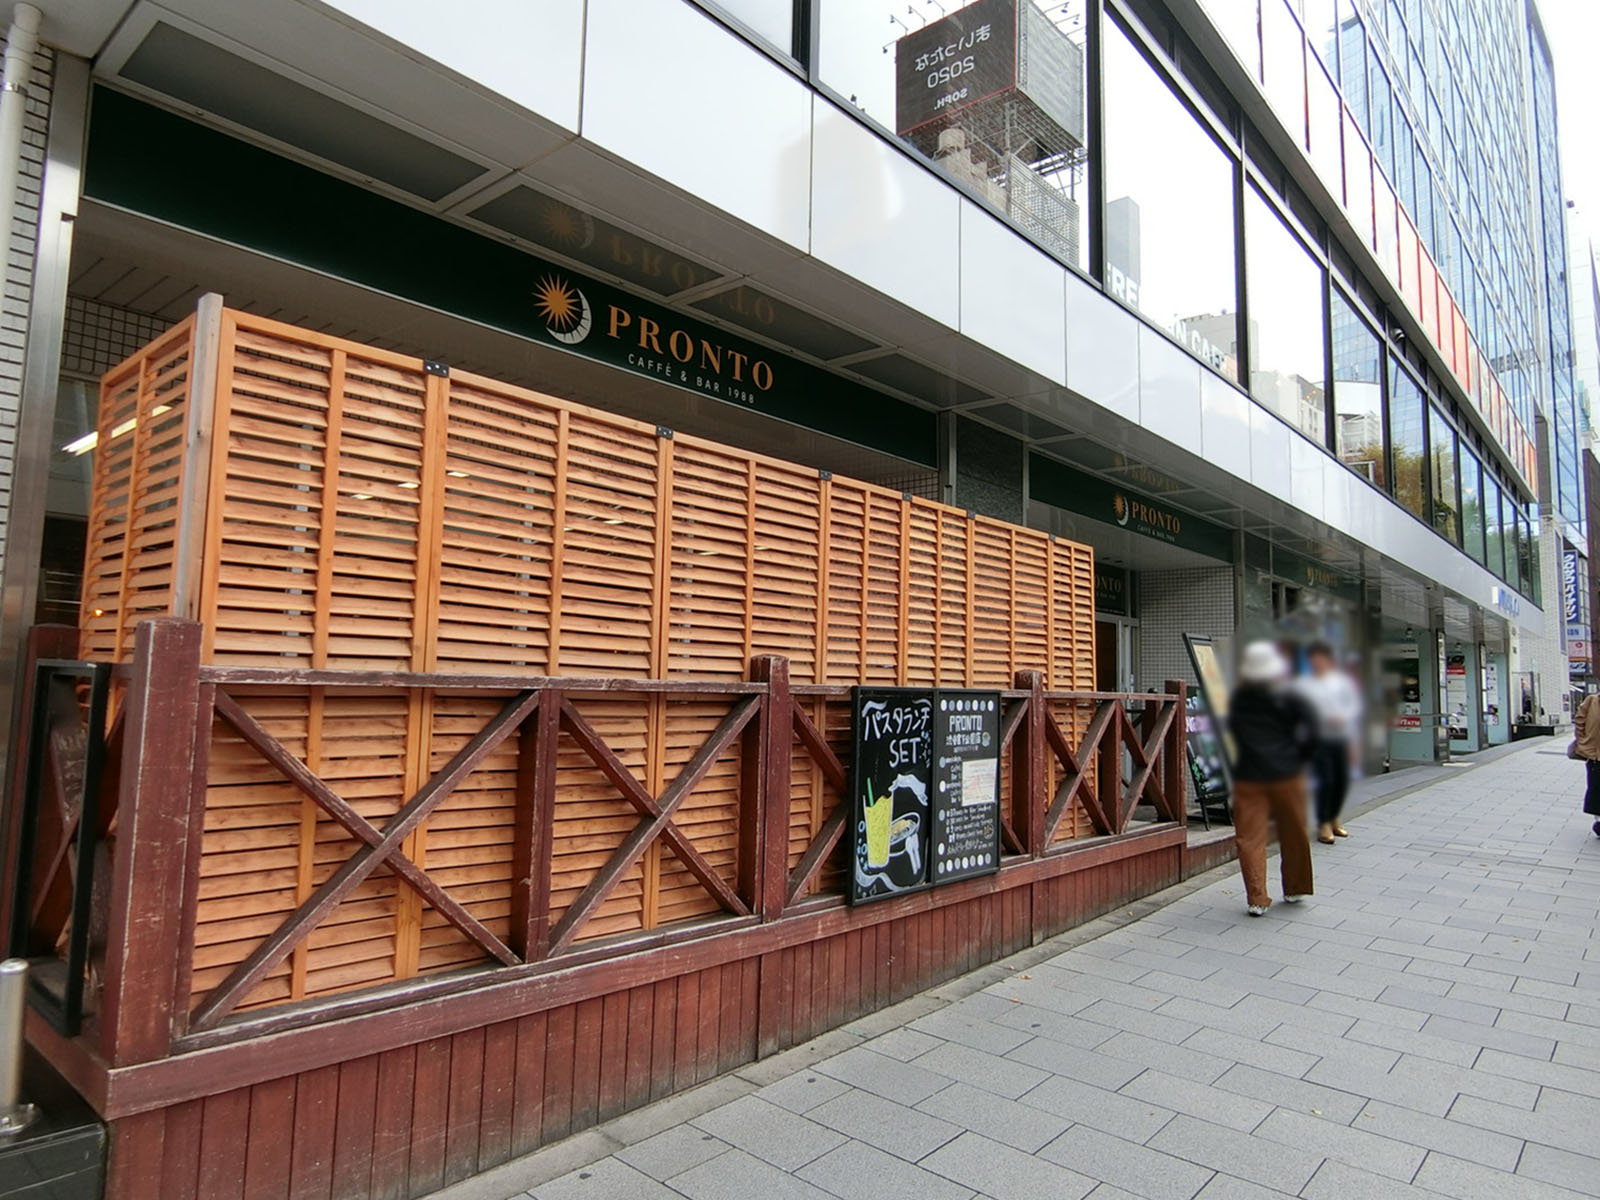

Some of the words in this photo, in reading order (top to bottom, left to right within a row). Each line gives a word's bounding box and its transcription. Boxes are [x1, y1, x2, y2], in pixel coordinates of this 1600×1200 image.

[607, 304, 774, 391] PRONTO
[680, 371, 687, 382] &
[696, 376, 720, 393] BAR
[728, 387, 754, 404] 1988
[1132, 501, 1180, 534] PRONTO
[863, 707, 931, 742] パスタランチ
[949, 714, 982, 732] PRONTO
[889, 737, 921, 768] SET
